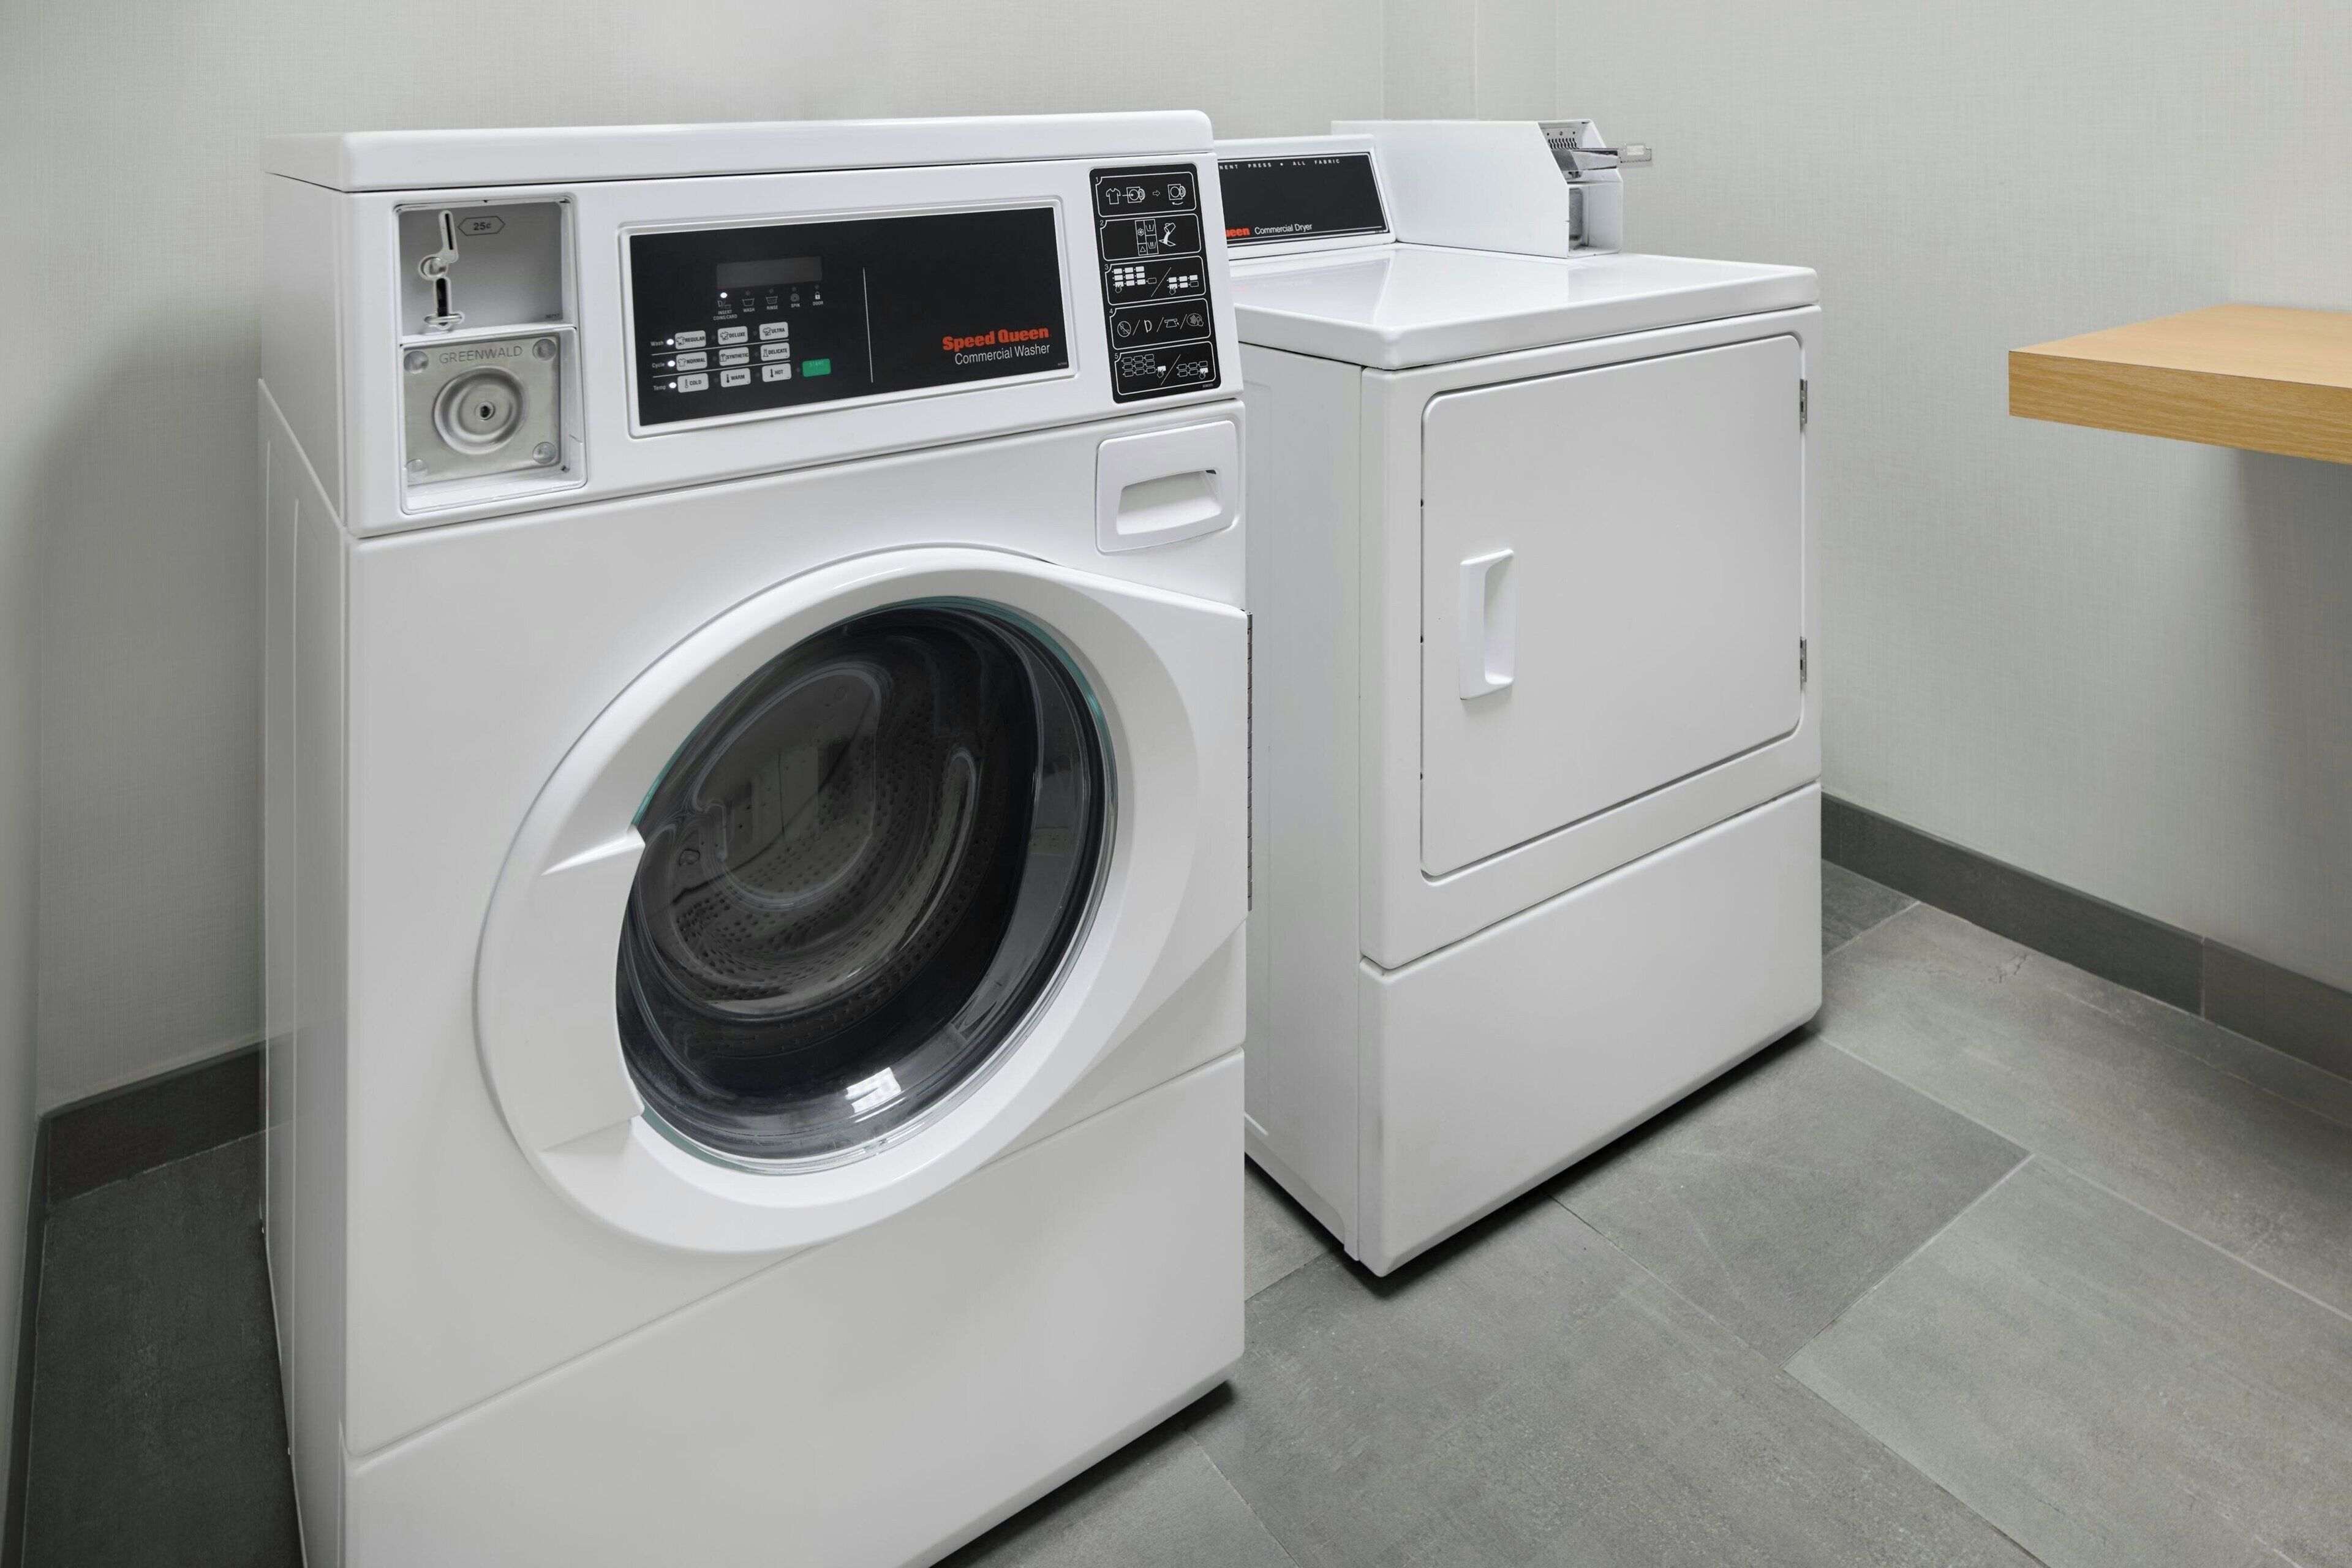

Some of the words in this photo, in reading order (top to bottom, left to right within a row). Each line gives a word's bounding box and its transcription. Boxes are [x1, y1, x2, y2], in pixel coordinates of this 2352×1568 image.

[1254, 225, 1294, 235] Commercial
[1294, 223, 1313, 233] Dryer
[942, 331, 995, 353] Speed
[998, 326, 1049, 343] Queen
[439, 345, 523, 364] GREENWALD
[954, 347, 1013, 366] Commercial
[1014, 344, 1050, 358] Washer
